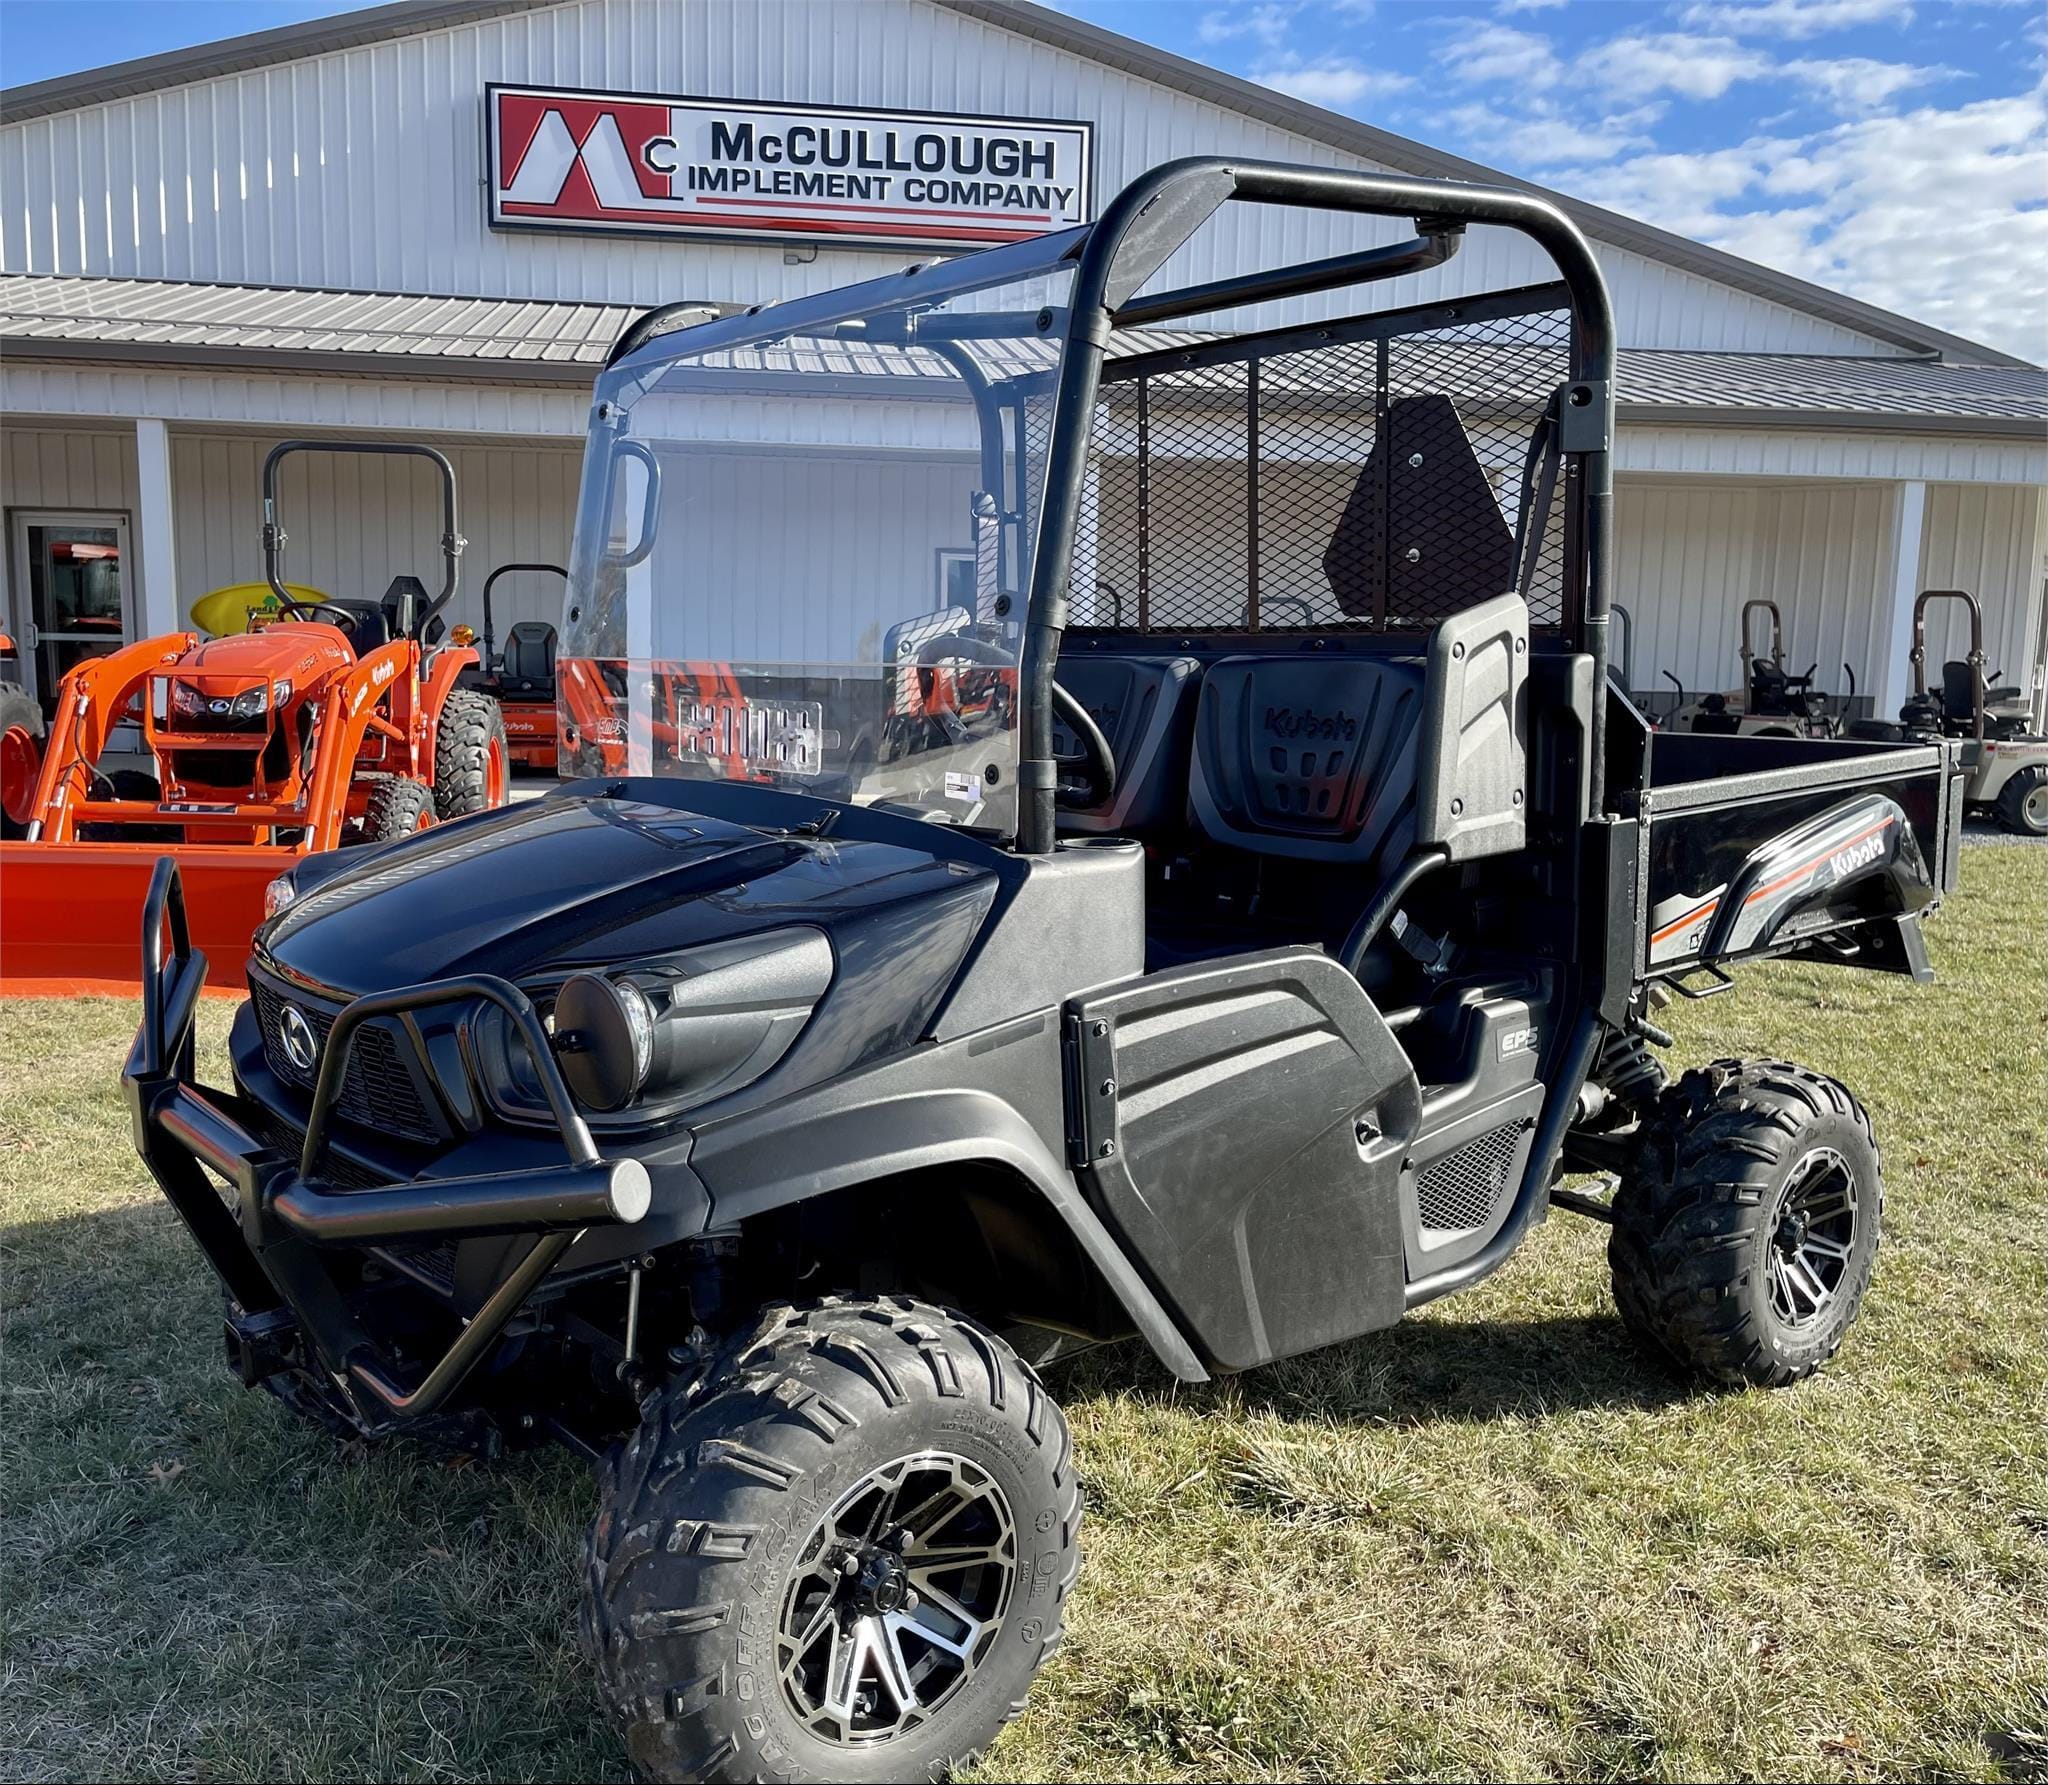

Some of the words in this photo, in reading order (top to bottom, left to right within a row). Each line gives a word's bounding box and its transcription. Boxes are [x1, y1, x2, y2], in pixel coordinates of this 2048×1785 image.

[711, 121, 1055, 179] McCULLOUGH
[689, 166, 891, 201] IMPLEMENT
[903, 178, 1073, 211] COMPANY
[1264, 706, 1357, 742] Kubota
[1829, 834, 1886, 879] Kubota
[1502, 1026, 1538, 1051] EPS
[735, 1601, 758, 1702] OFF
